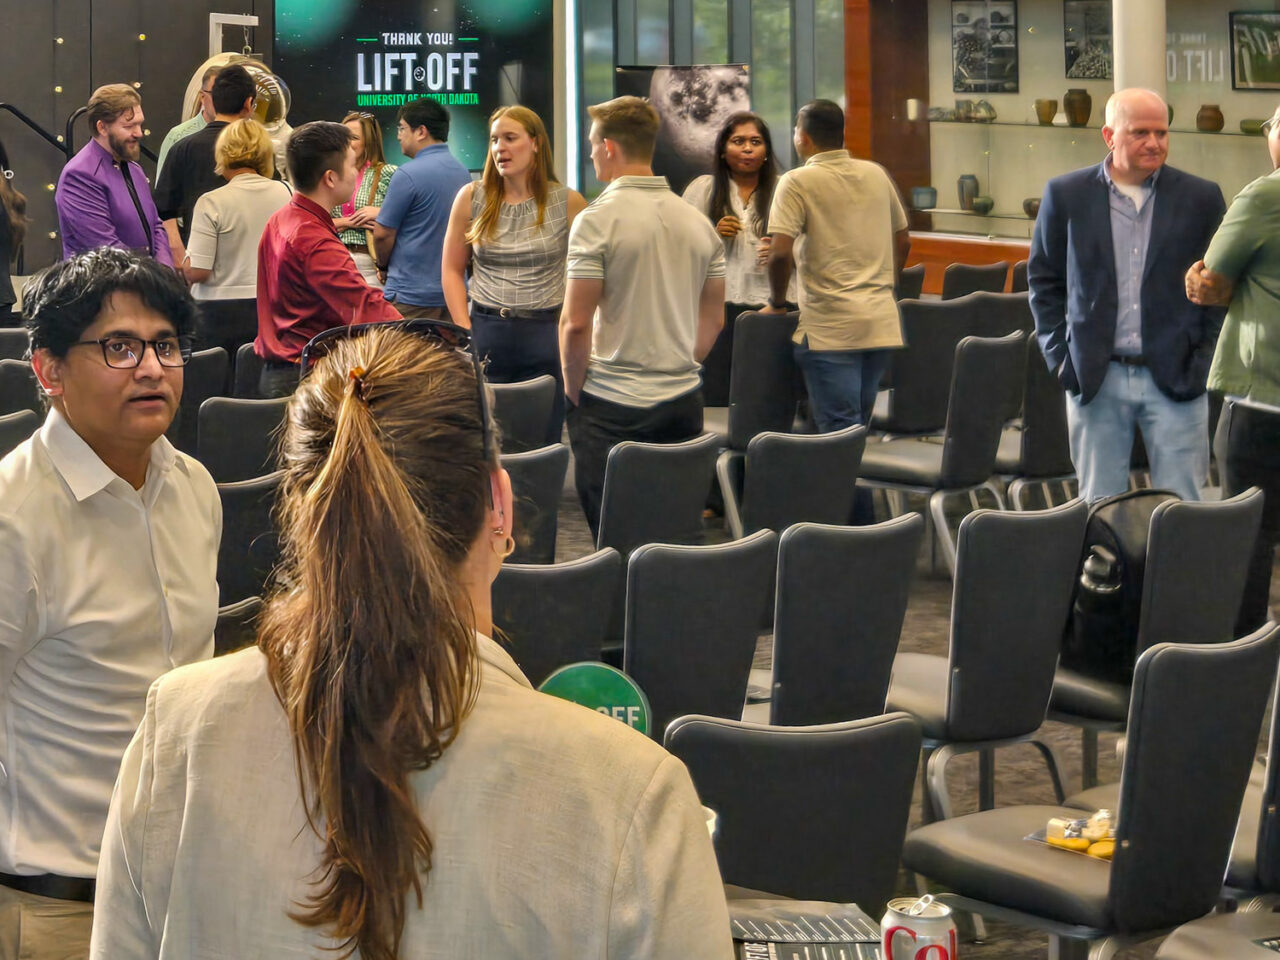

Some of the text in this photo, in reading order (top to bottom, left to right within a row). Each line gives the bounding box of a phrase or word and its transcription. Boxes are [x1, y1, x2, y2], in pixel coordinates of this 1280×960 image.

[382, 32, 453, 45] THANK YOU!
[357, 52, 479, 92] LIFT OFF
[357, 93, 406, 107] UNIVERSITY
[449, 92, 479, 105] DAKOTA
